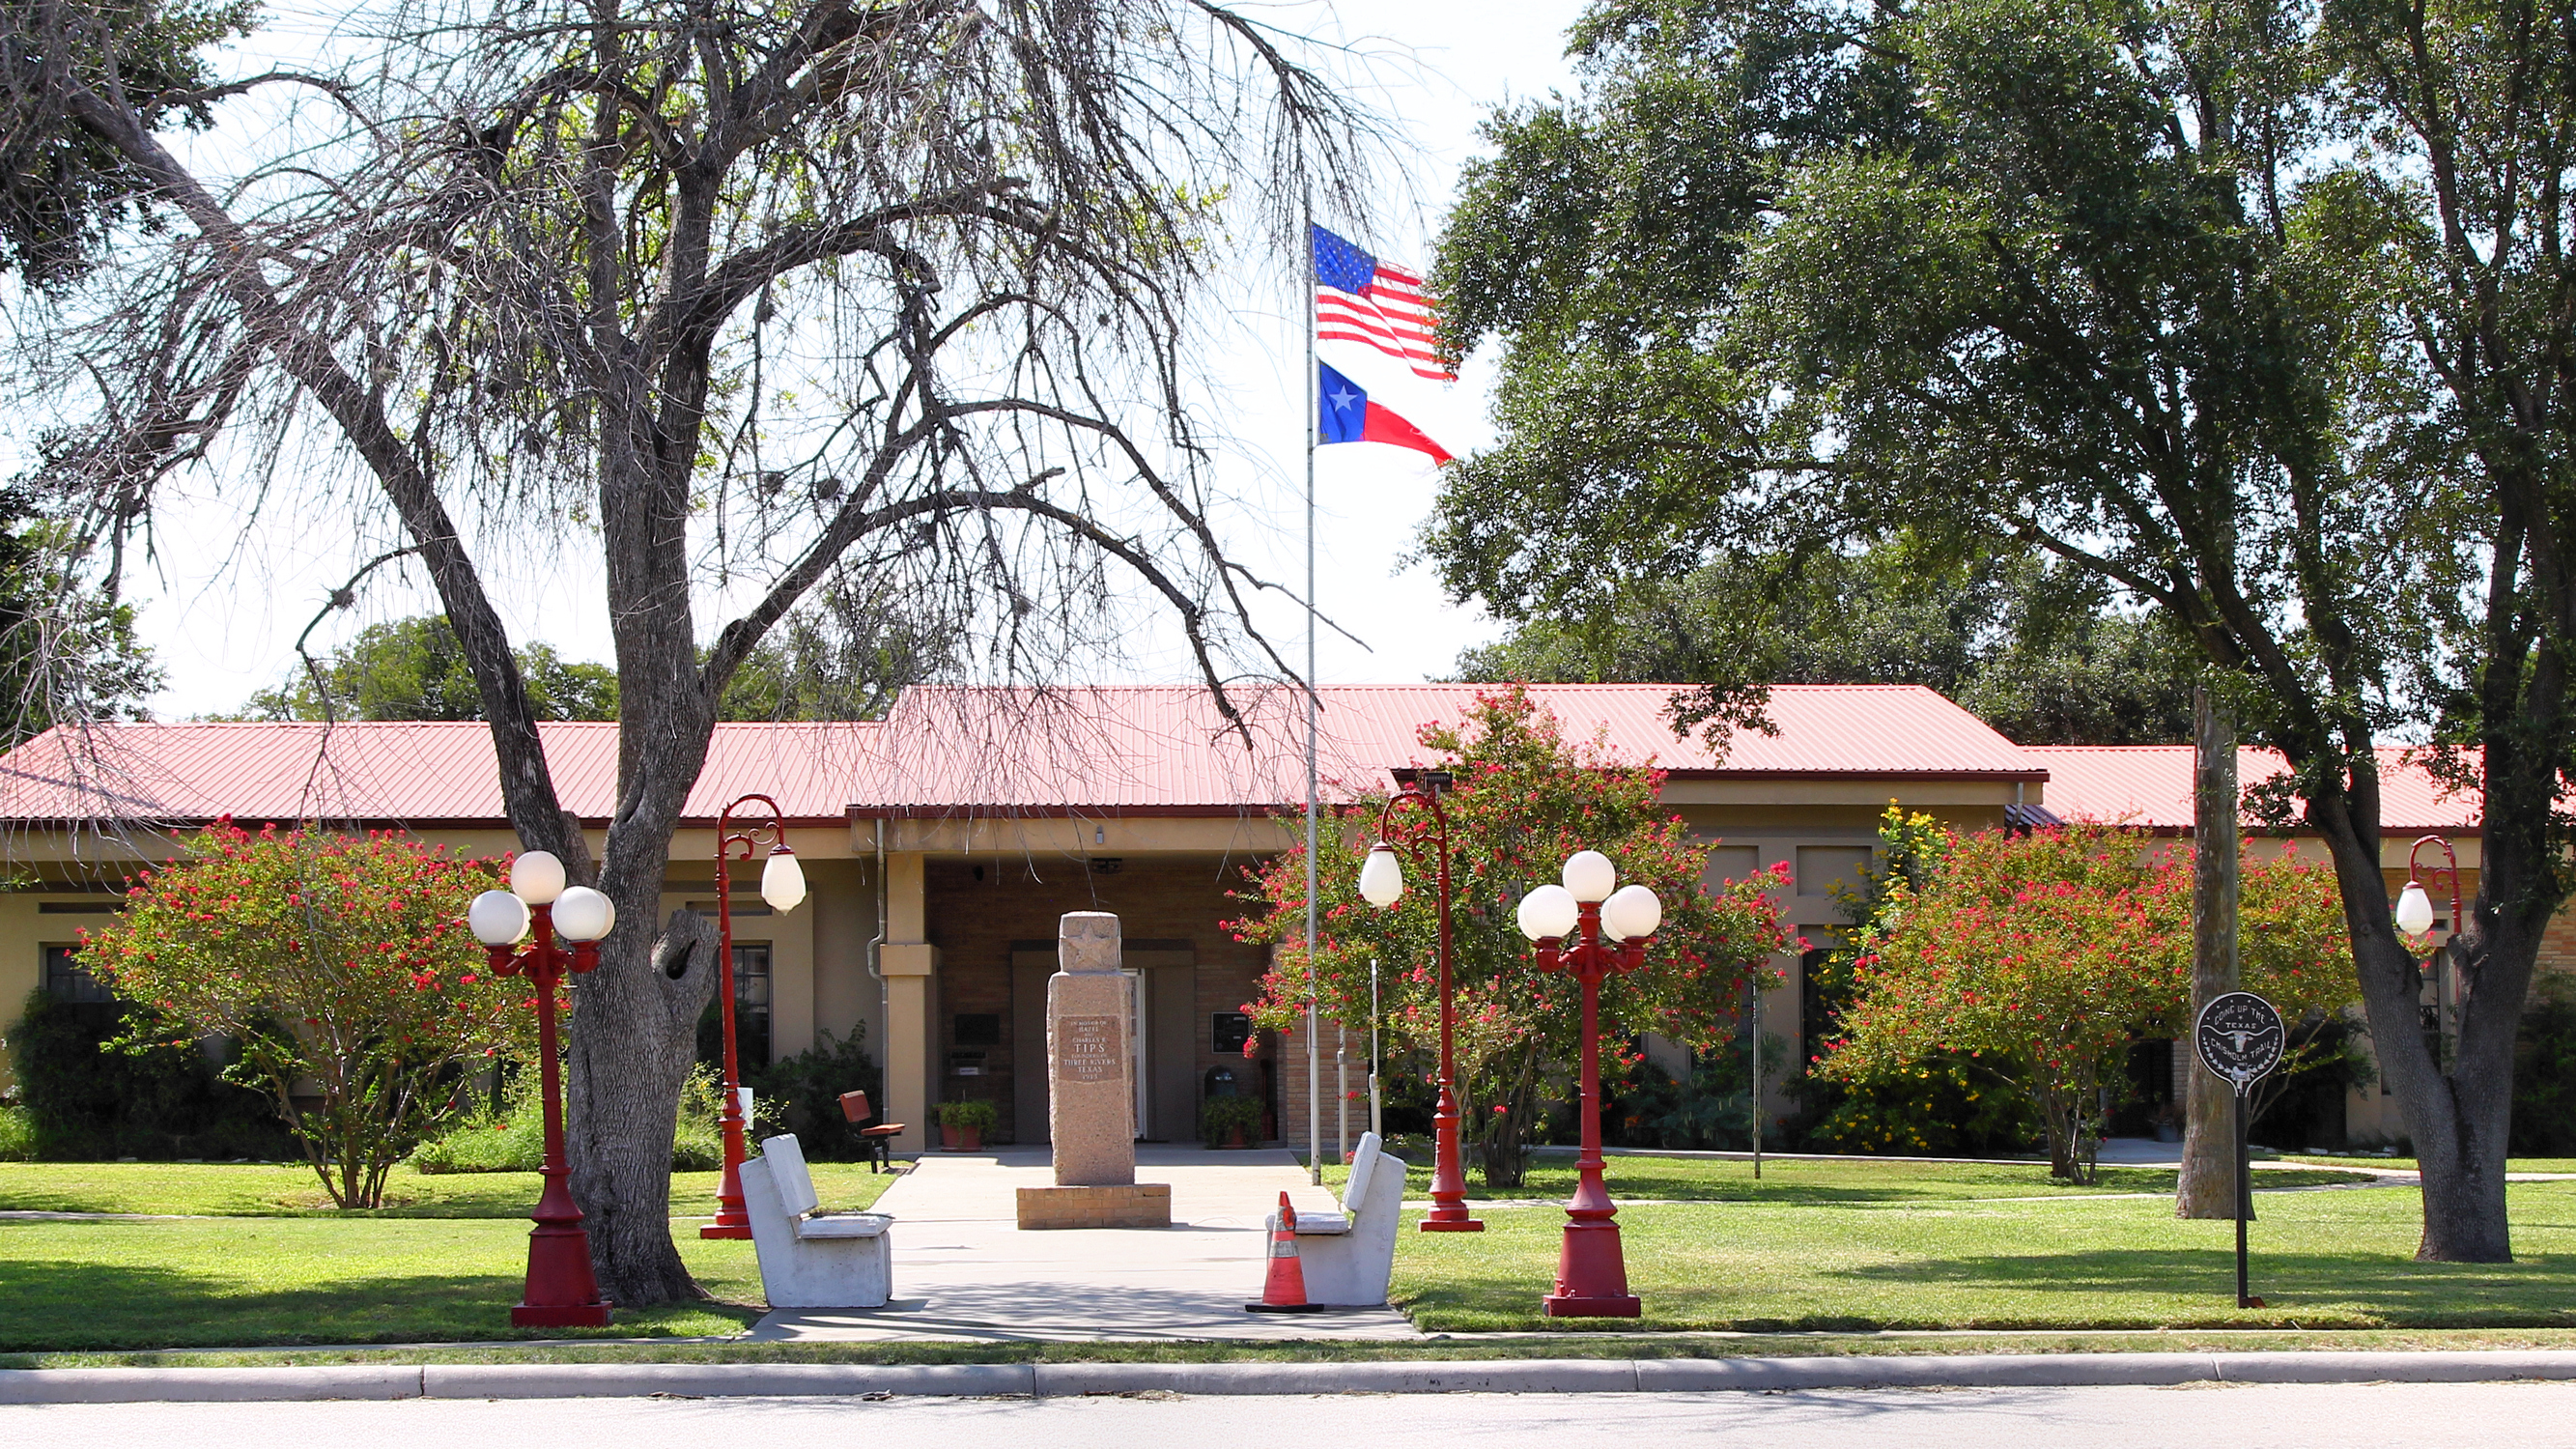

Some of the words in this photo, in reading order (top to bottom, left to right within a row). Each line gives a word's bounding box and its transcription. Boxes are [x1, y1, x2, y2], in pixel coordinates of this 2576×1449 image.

[2215, 1006, 2235, 1026] GOING
[2237, 1005, 2248, 1013] UP
[2250, 1008, 2265, 1025] THE
[1073, 1043, 1105, 1053] TIPS
[2211, 1037, 2248, 1062] CHISHOLM
[2250, 1040, 2272, 1059] TRAIL
